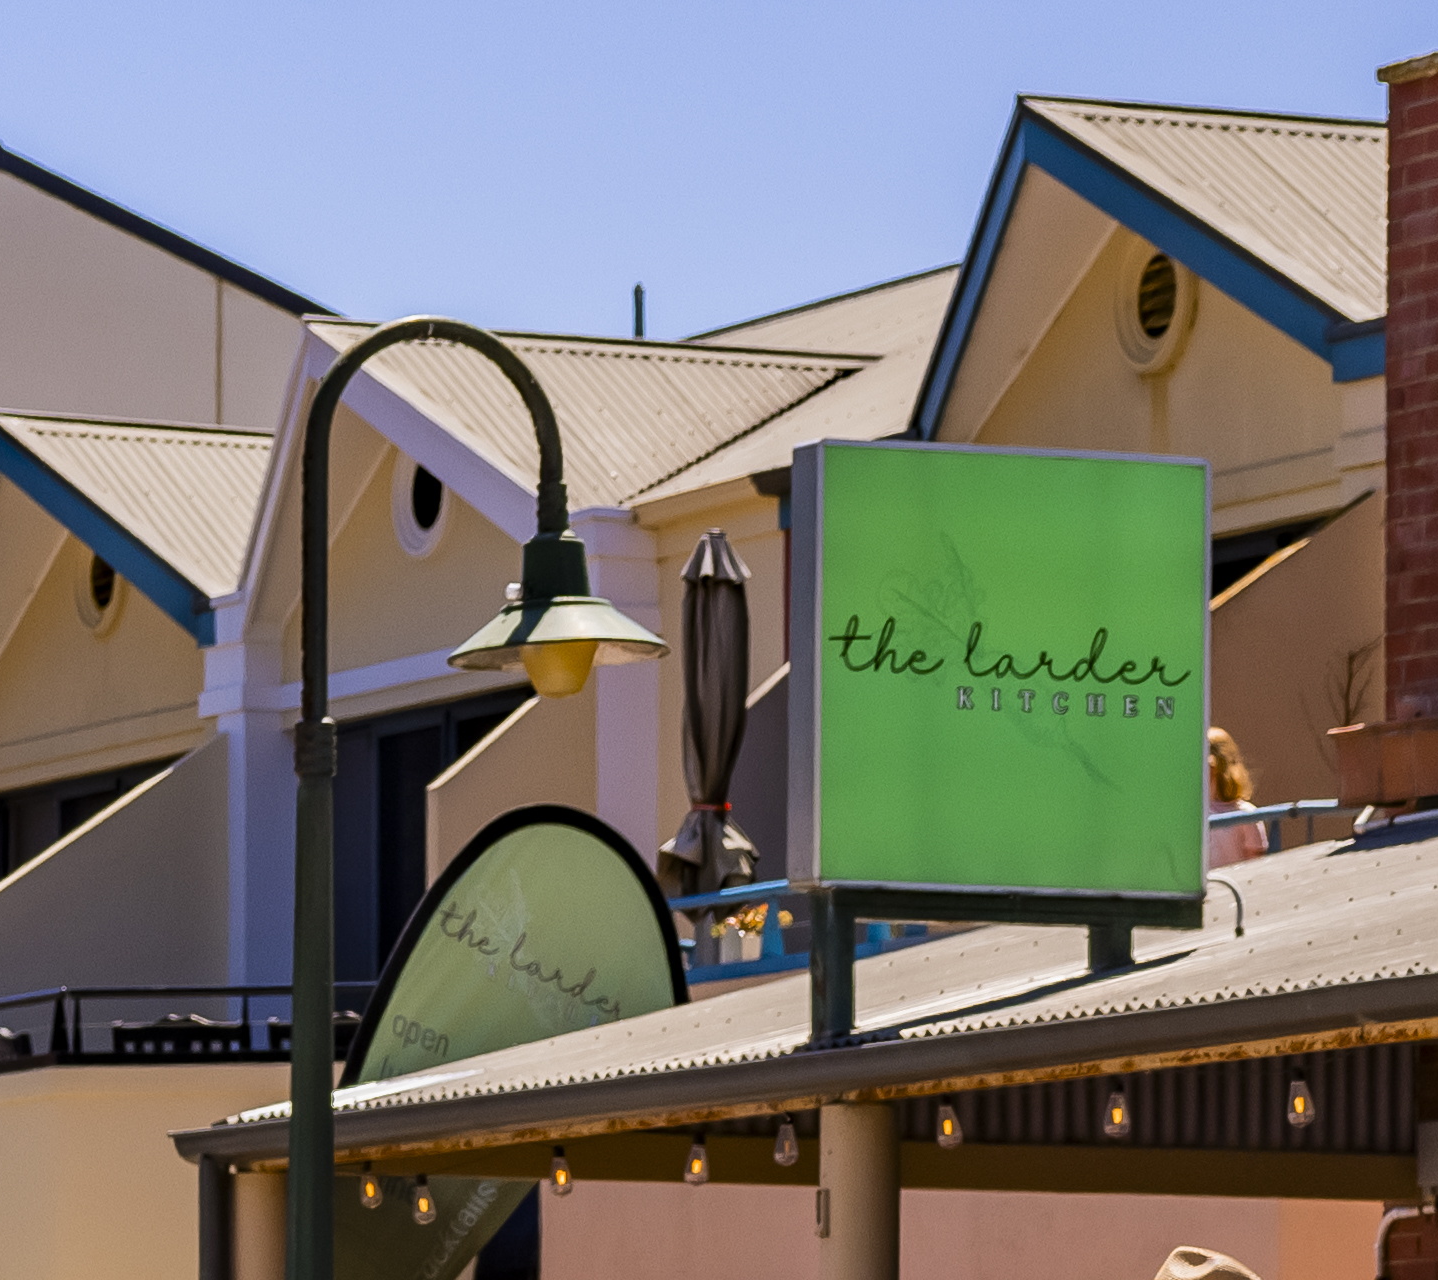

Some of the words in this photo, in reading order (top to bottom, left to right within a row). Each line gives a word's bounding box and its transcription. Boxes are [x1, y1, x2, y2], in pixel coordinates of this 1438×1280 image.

[829, 614, 944, 674] the
[964, 621, 1190, 686] larder
[956, 686, 1175, 719] KITCHEN
[440, 901, 499, 956] the
[392, 1014, 450, 1058] open
